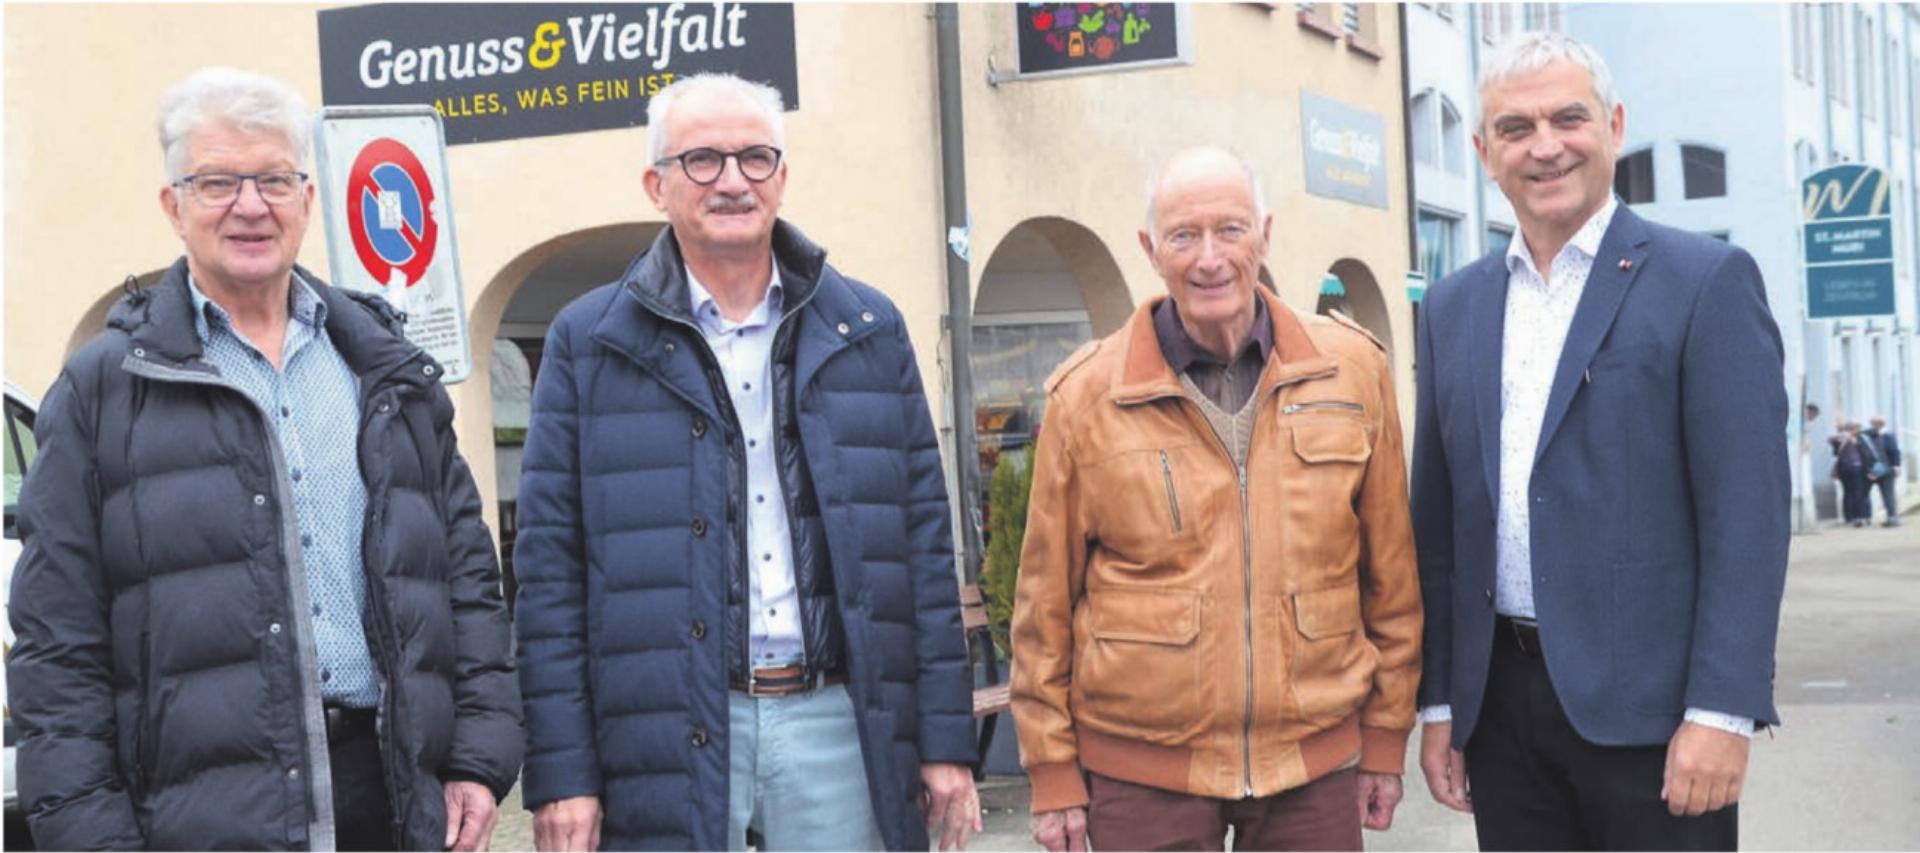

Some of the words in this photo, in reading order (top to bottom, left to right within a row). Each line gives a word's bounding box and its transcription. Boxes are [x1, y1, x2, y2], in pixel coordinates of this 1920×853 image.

[433, 92, 508, 118] ALLES,
[516, 86, 569, 110] WAS
[577, 78, 630, 104] FEIN
